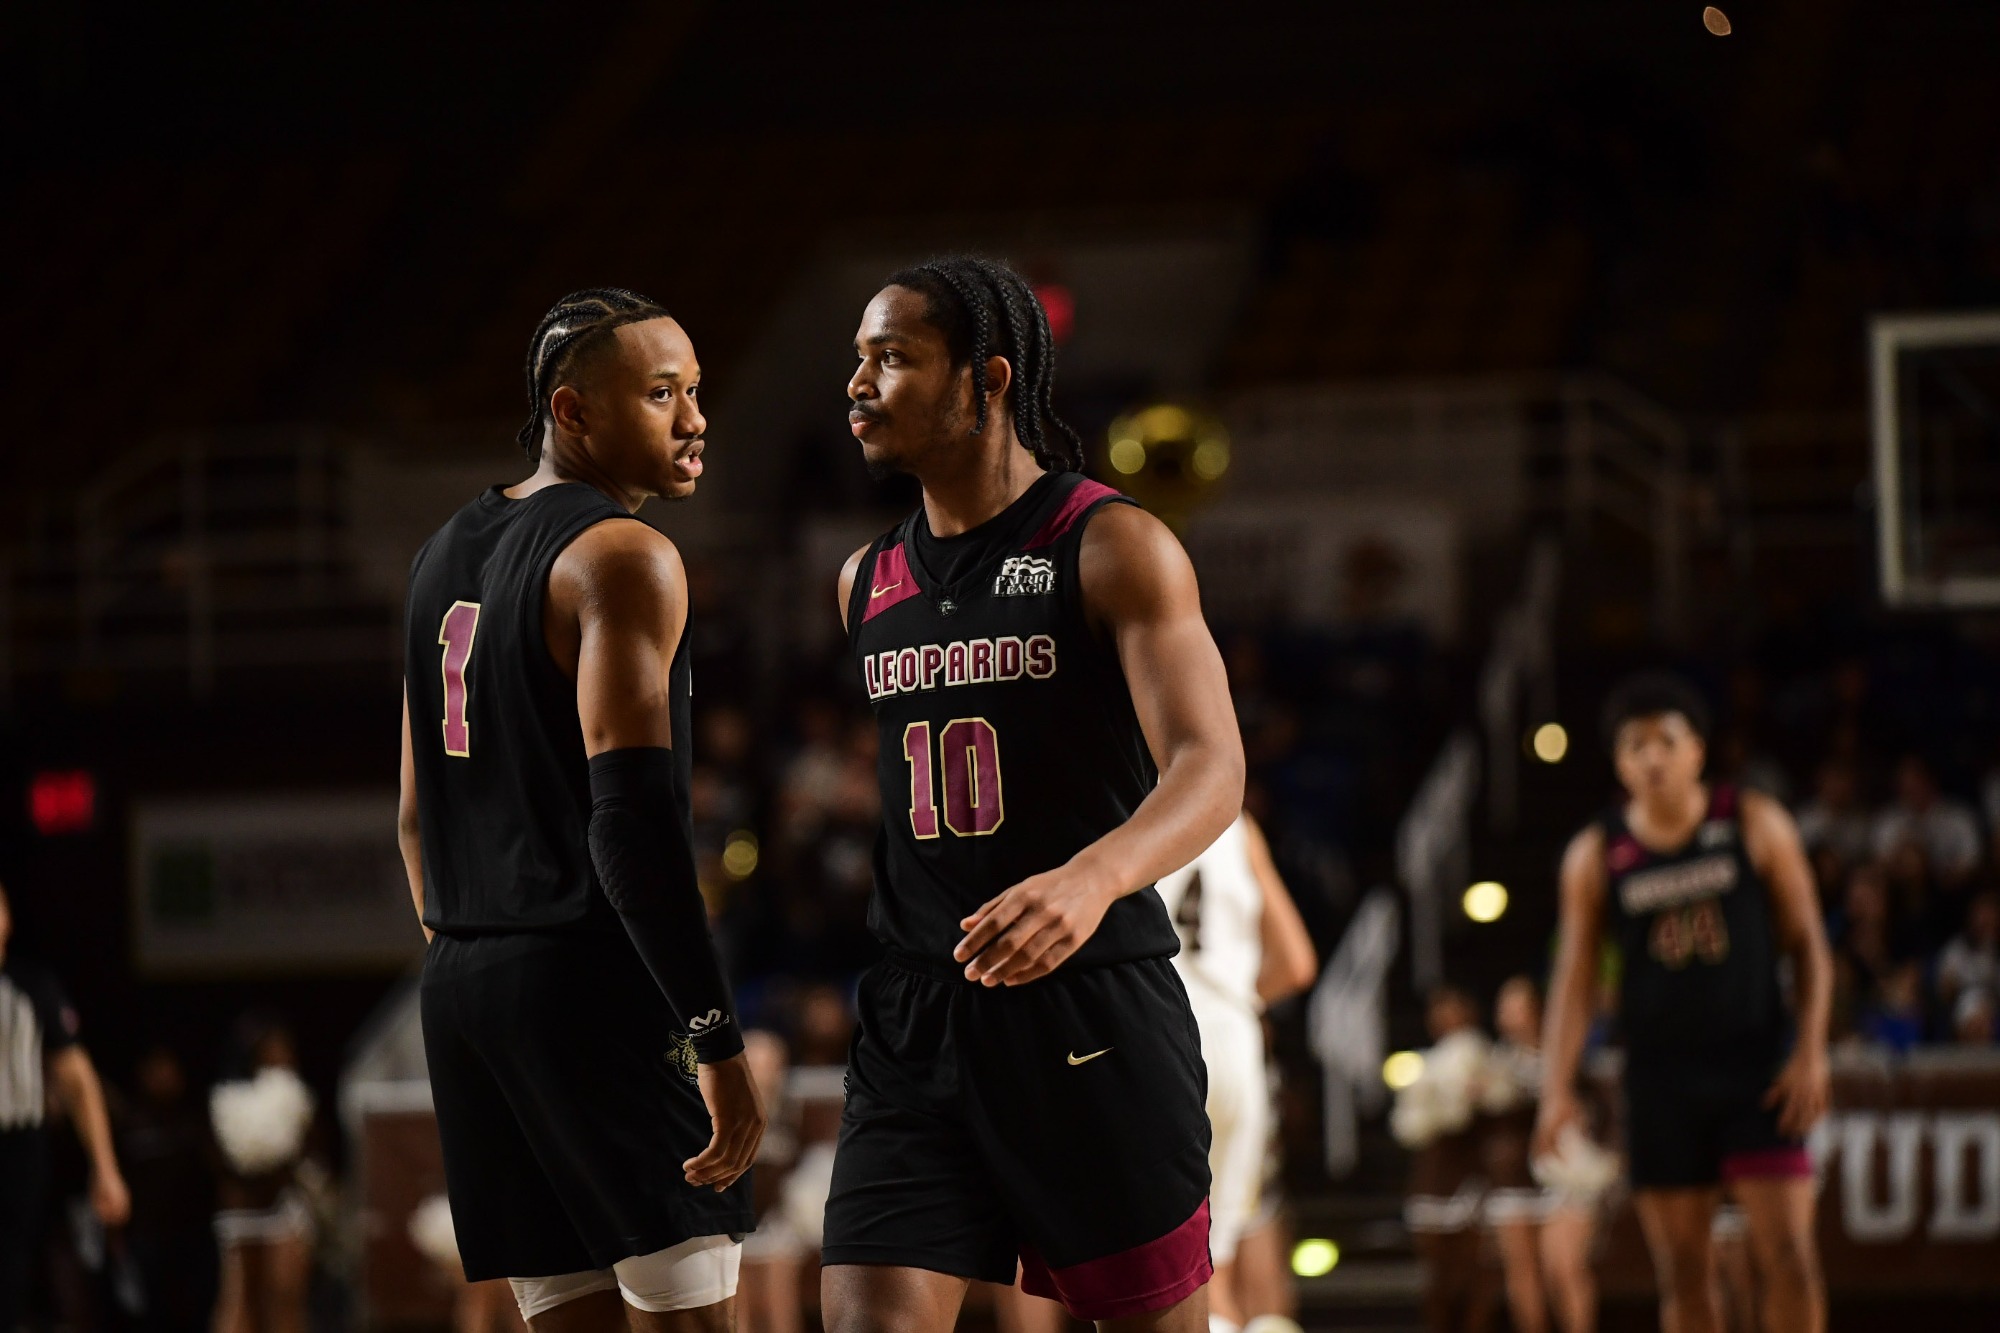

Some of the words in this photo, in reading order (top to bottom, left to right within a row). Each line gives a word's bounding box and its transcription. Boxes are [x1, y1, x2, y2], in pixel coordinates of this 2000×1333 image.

[993, 581, 1056, 595] LEAGUE
[994, 571, 1057, 586] PATRIOT
[438, 599, 481, 759] 1
[864, 634, 1057, 700] LEOPARDS
[902, 716, 1005, 840] 10
